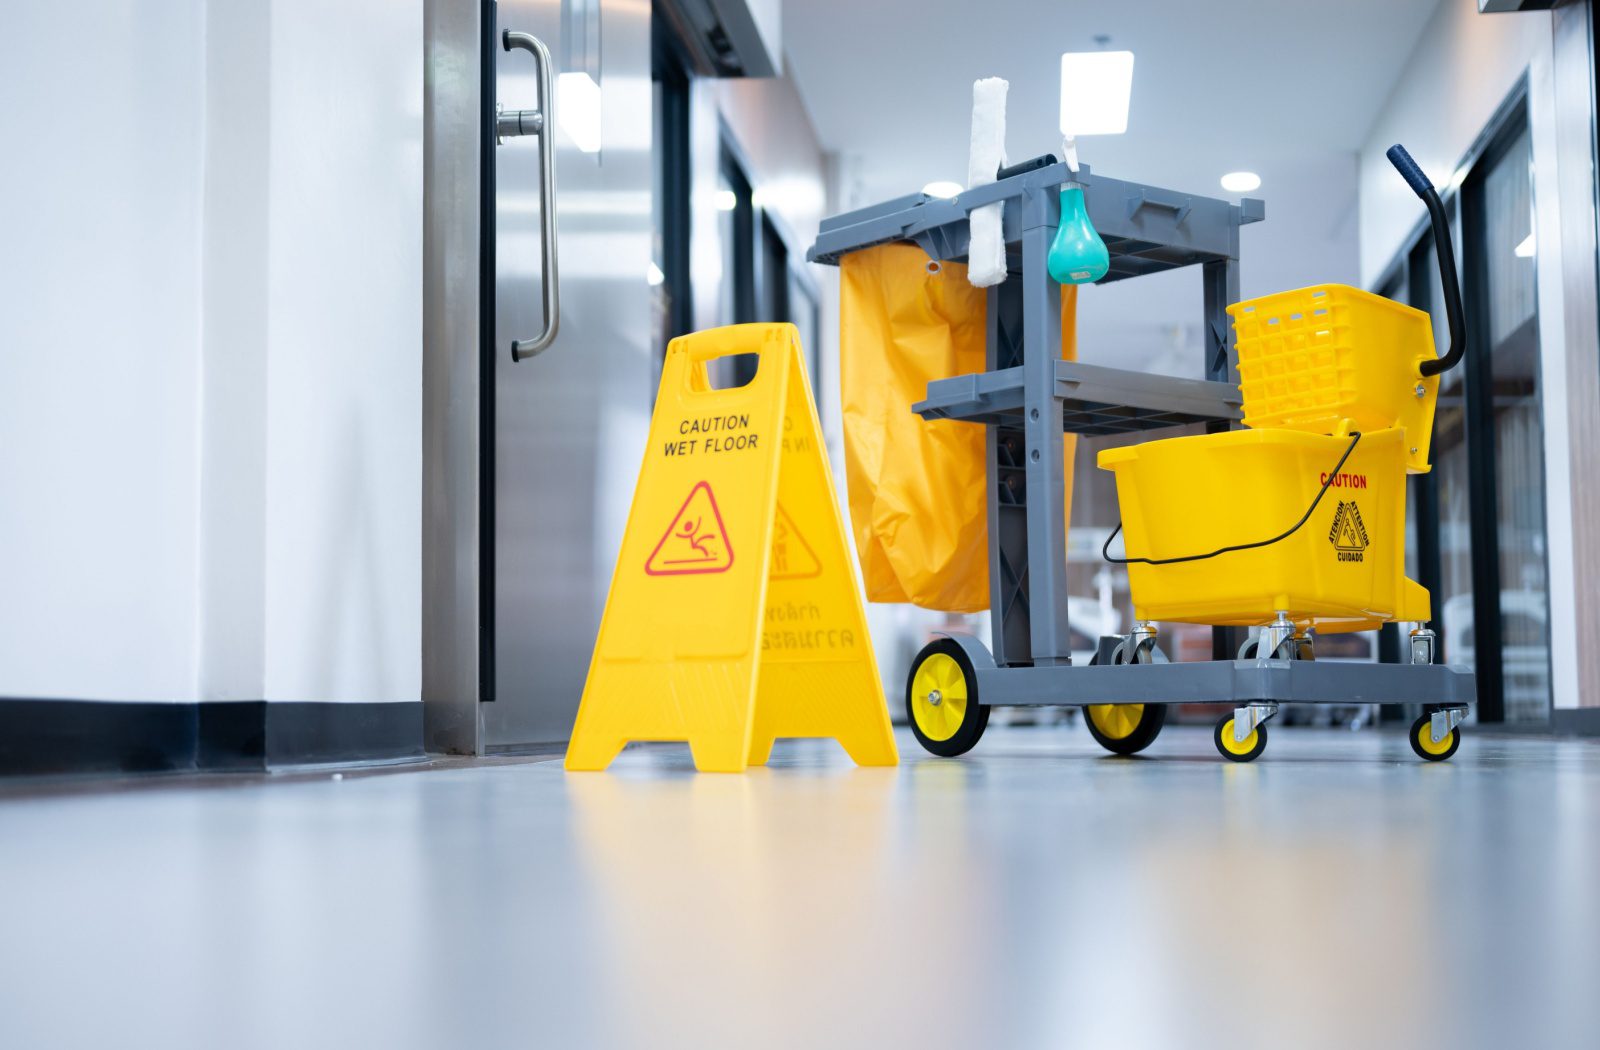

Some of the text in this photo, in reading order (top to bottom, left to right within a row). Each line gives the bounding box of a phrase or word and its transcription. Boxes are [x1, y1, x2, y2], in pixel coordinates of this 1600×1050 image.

[679, 414, 750, 435] CAUTION
[664, 434, 758, 457] WET FLOOR
[1320, 472, 1367, 489] CAUTION
[1328, 500, 1345, 544] ATENCION
[1350, 501, 1370, 547] ATTENTION
[1337, 552, 1364, 562] CUIDADO
